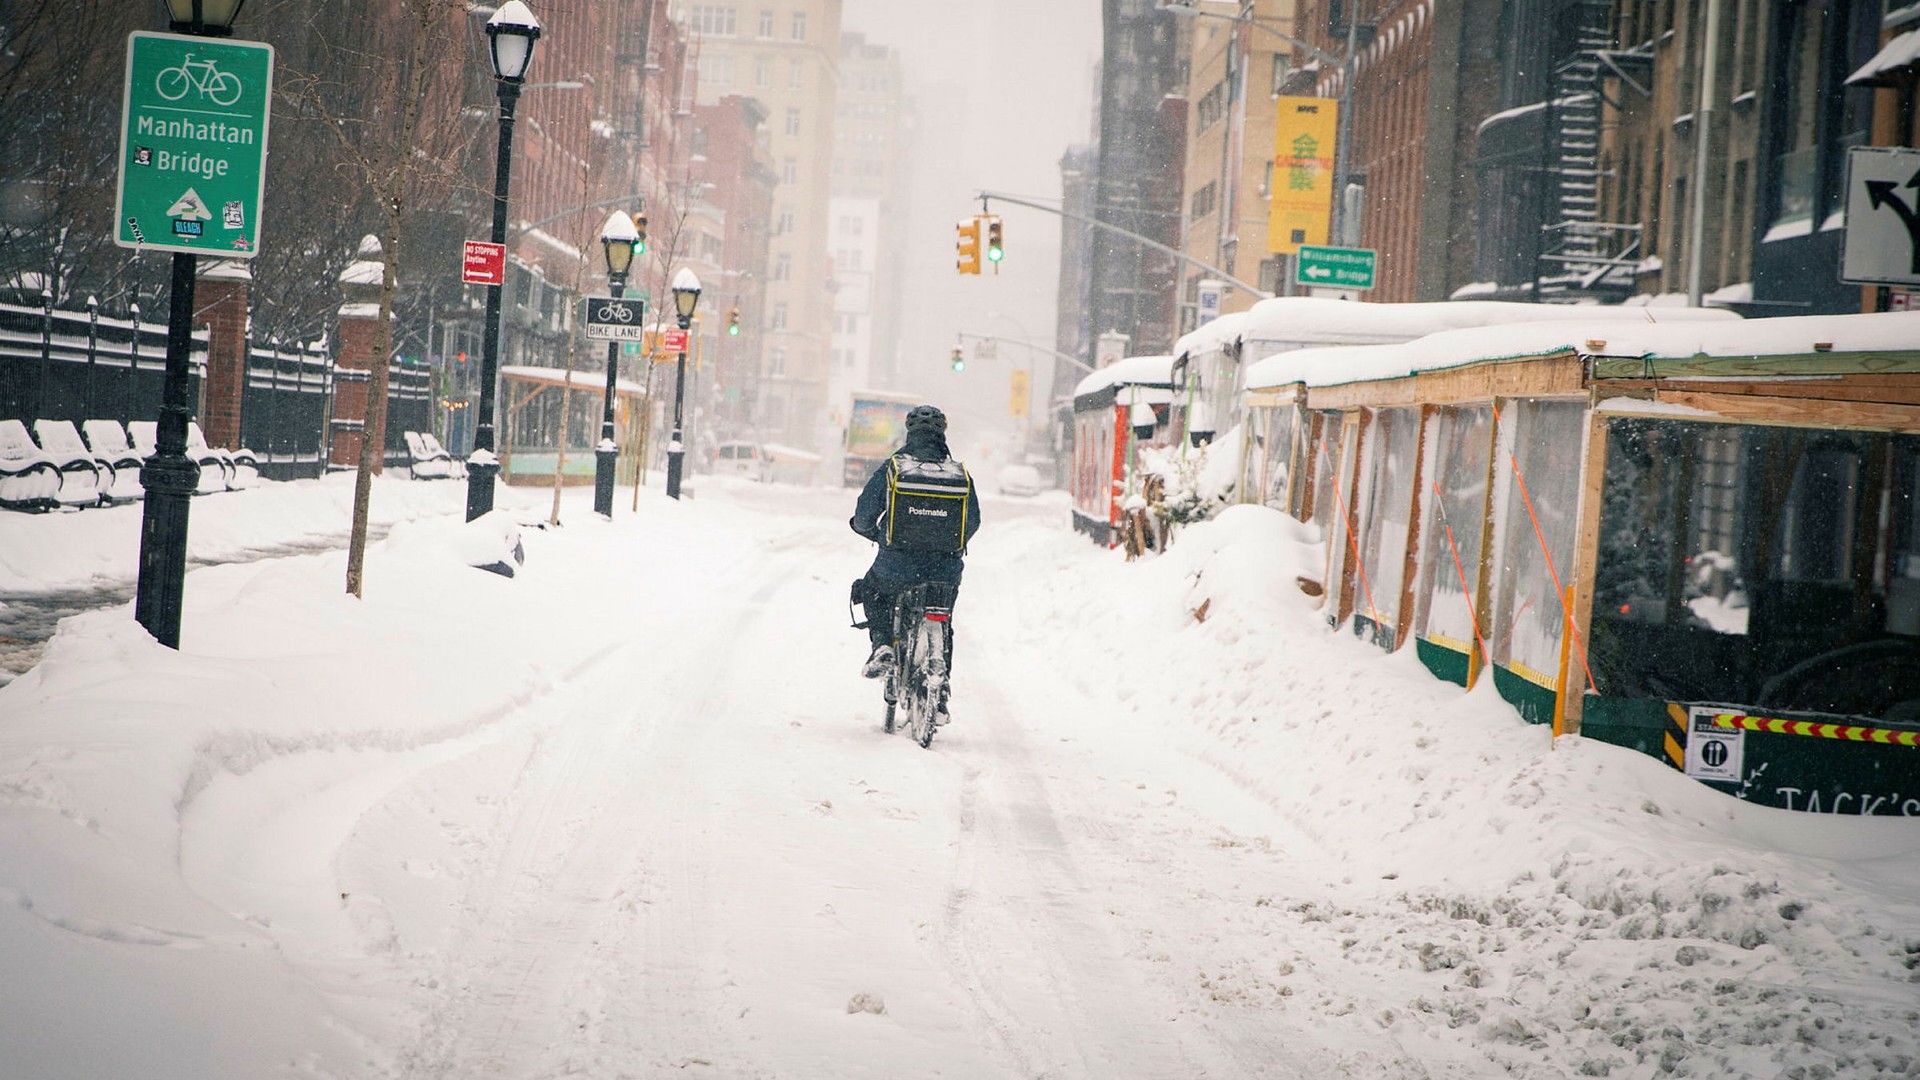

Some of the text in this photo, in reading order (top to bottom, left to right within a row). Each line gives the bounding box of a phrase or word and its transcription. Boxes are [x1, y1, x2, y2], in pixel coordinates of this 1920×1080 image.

[137, 115, 253, 145] Manhattan
[157, 151, 229, 180] Bridge
[175, 221, 201, 234] BLEACH
[466, 245, 499, 256] NO STOPPING
[466, 254, 487, 264] Anytime
[1302, 250, 1373, 268] Williamsburg
[1336, 269, 1370, 282] Bridge
[589, 325, 639, 338] BIKE LANE
[908, 506, 948, 517] Postmates
